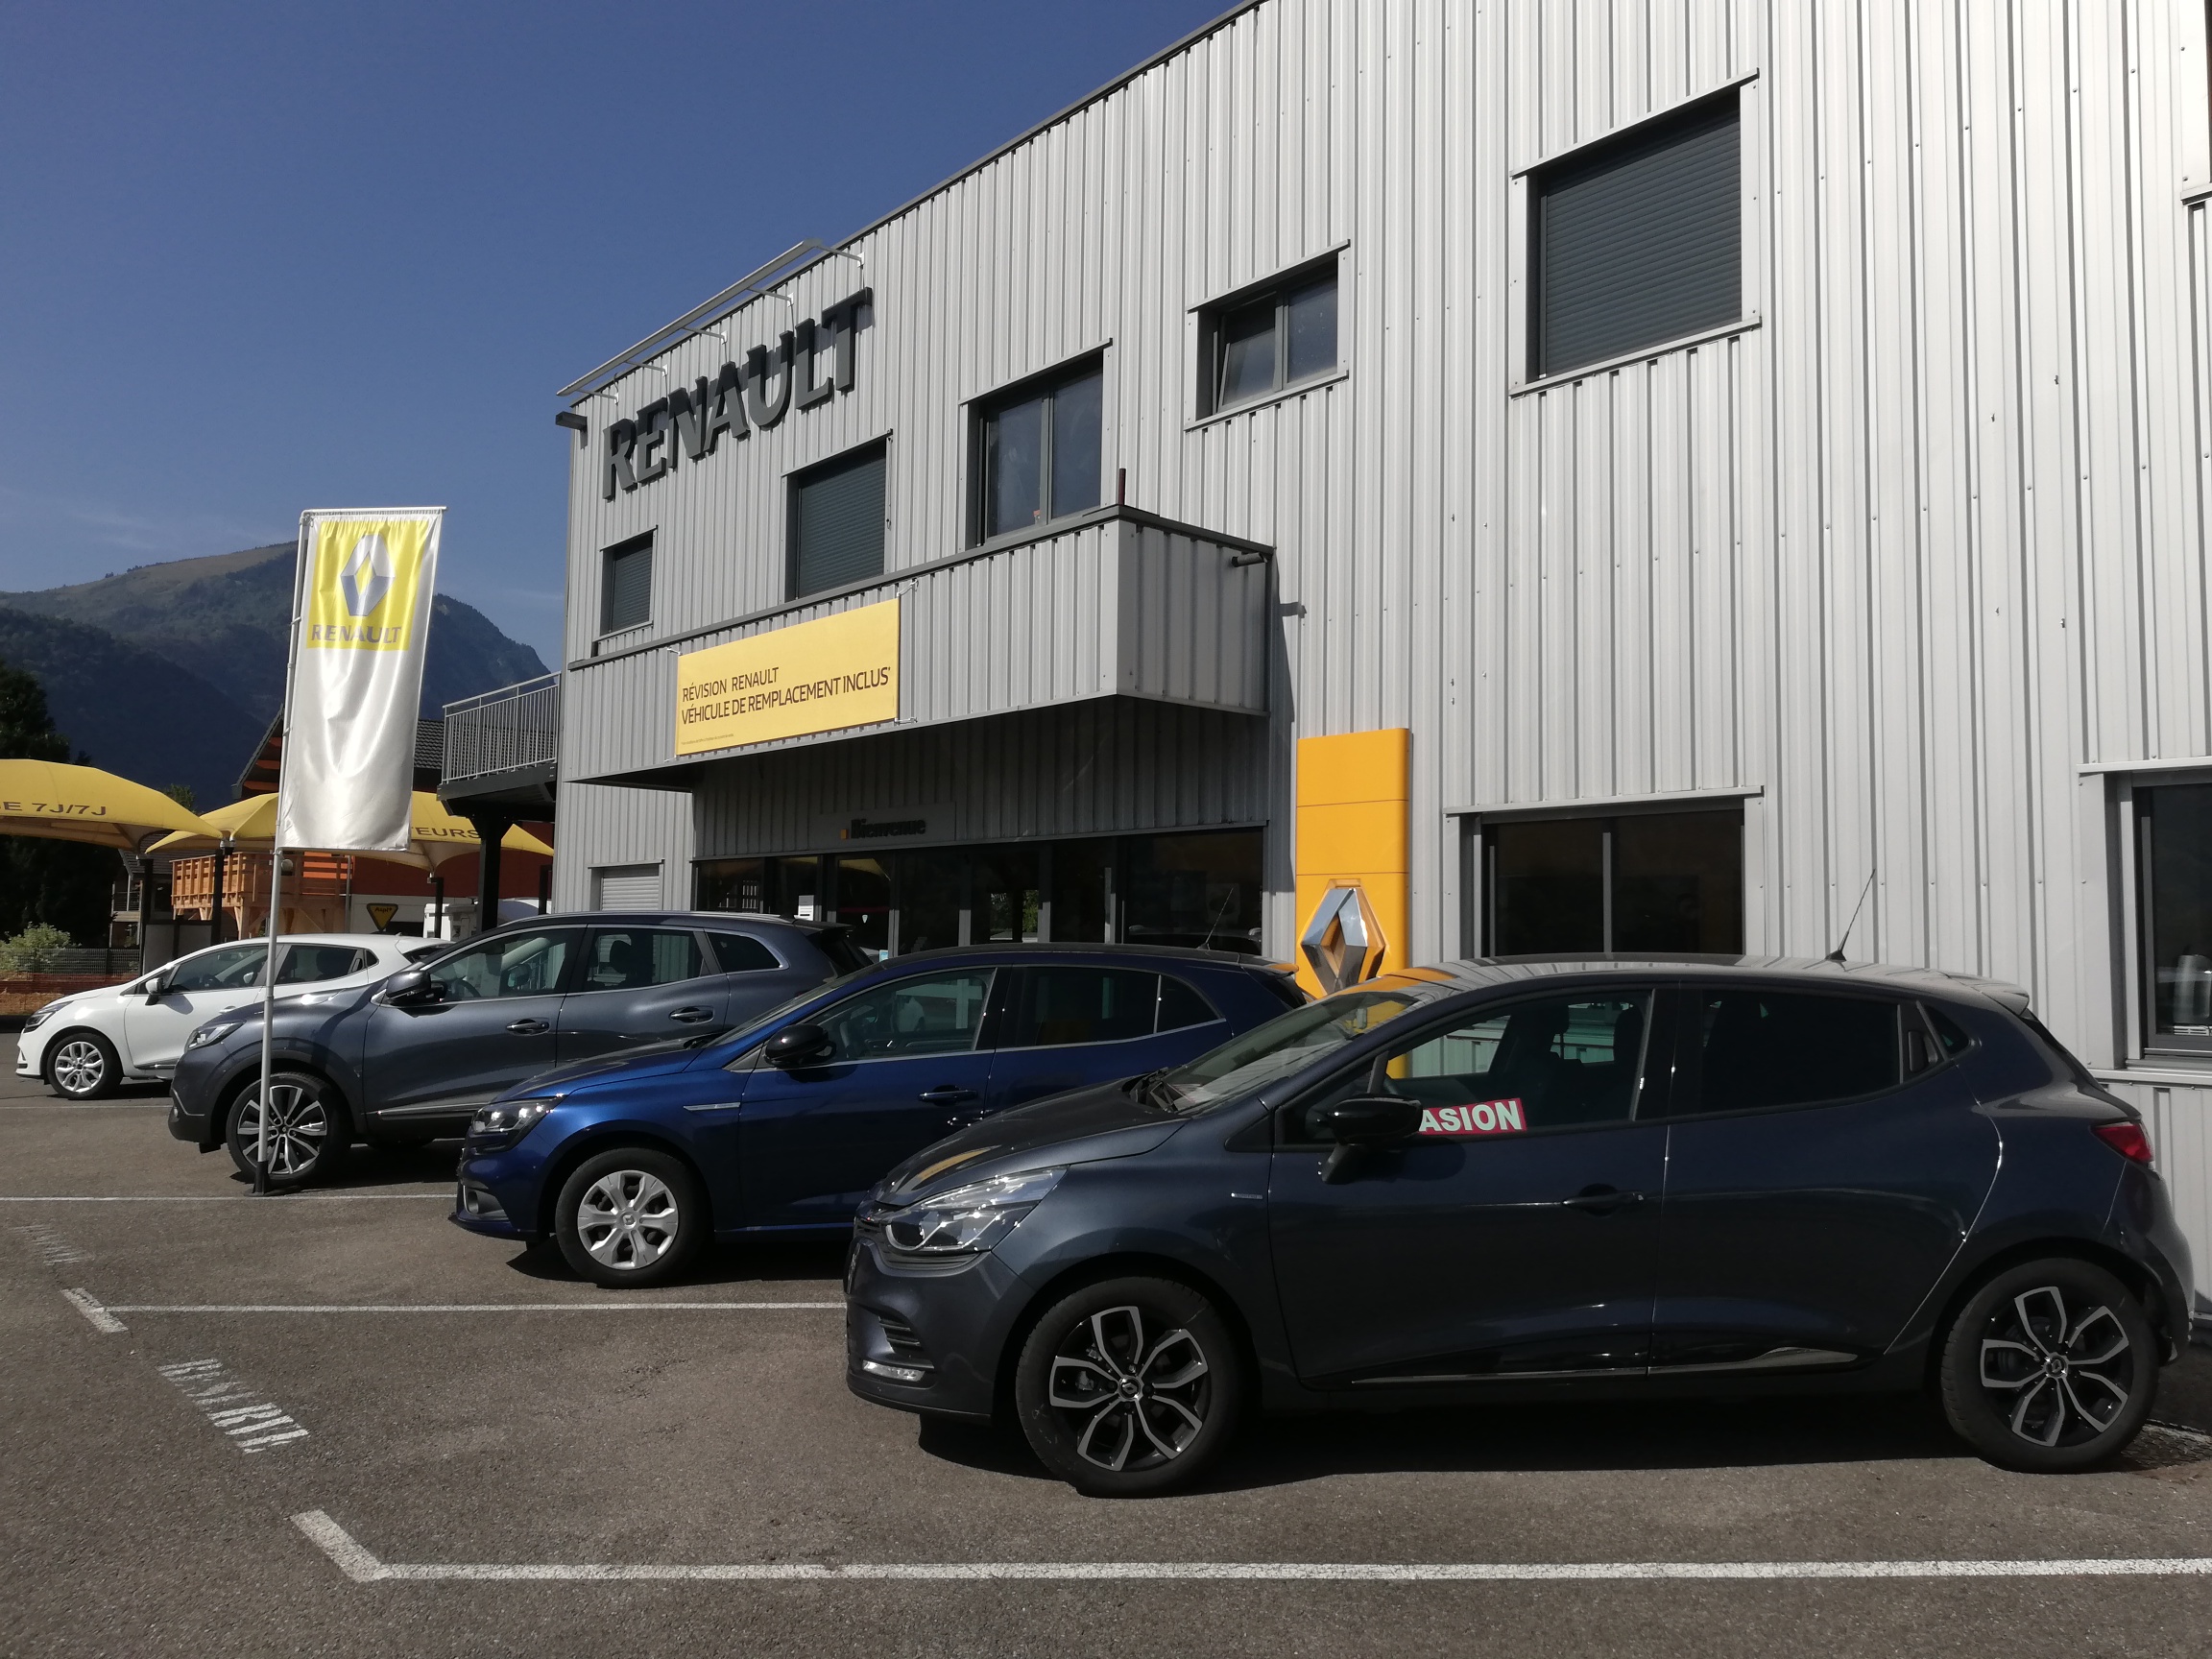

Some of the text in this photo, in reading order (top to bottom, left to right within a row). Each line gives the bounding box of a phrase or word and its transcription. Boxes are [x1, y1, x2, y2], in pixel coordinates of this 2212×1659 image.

[602, 287, 873, 501] RENAULT
[311, 624, 401, 644] RENAULT
[682, 666, 780, 703] RÉVISION RENAULT
[682, 704, 731, 725] VÉHICULE
[732, 697, 747, 716] DE
[748, 677, 842, 712] REMPLACEMENT
[0, 801, 107, 816] E 7J/7J
[411, 827, 480, 839] EURS
